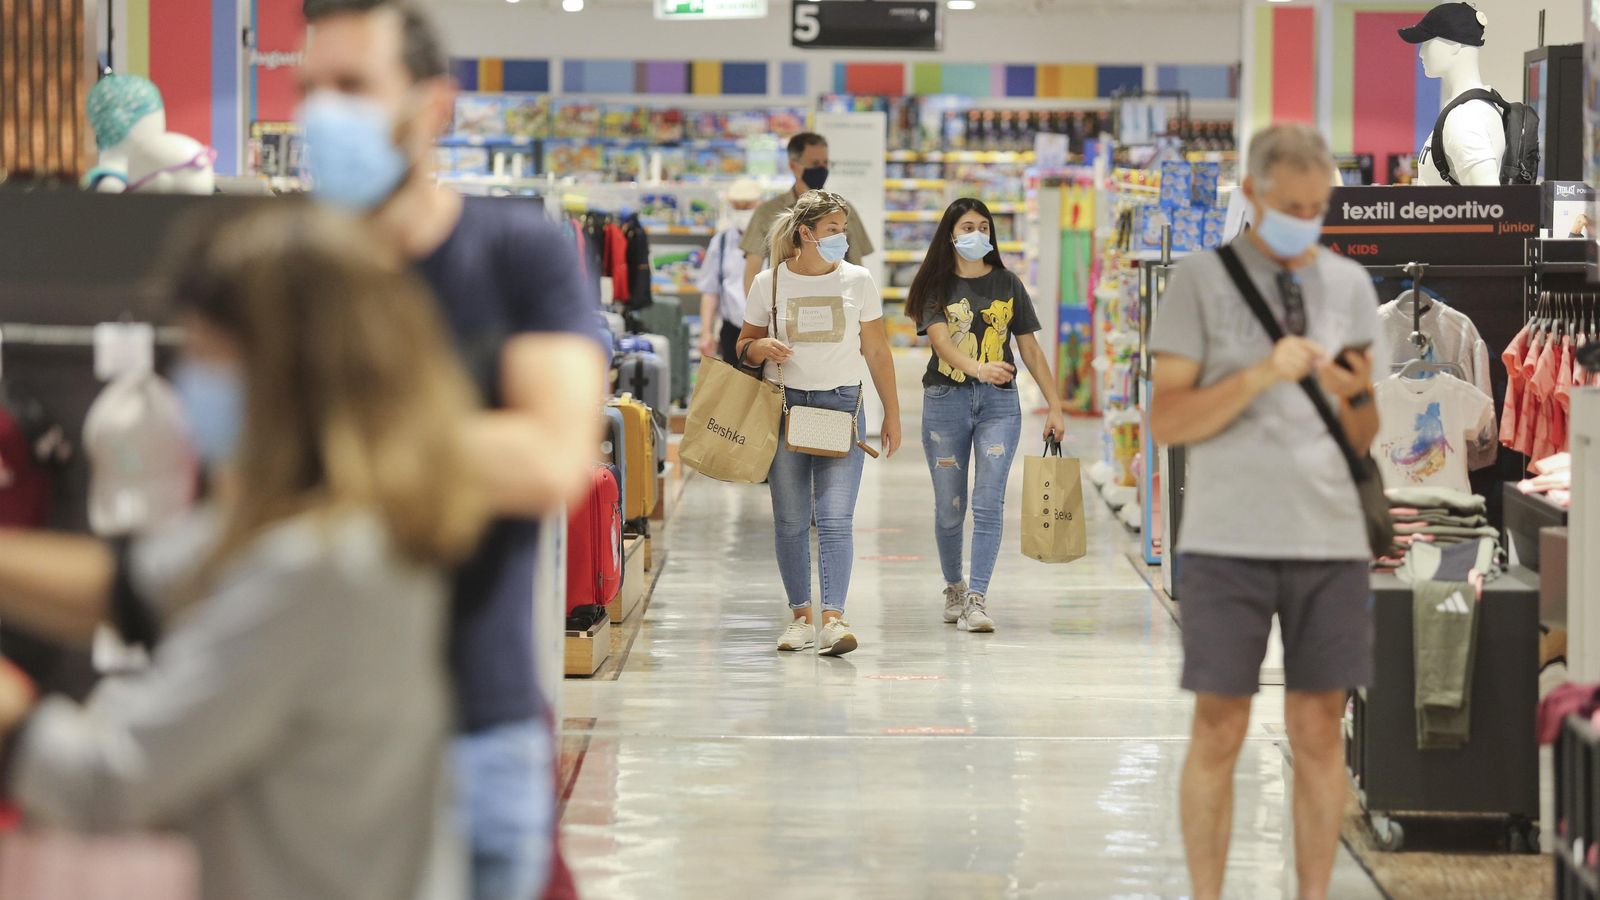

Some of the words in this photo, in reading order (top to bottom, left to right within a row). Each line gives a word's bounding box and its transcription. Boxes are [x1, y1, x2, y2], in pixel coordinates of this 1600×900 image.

[794, 5, 820, 42] 5
[1342, 201, 1395, 220] textil
[1400, 201, 1504, 222] deportivo
[1498, 221, 1535, 235] júnior
[1347, 244, 1379, 255] KIDS
[706, 417, 746, 445] Bershka
